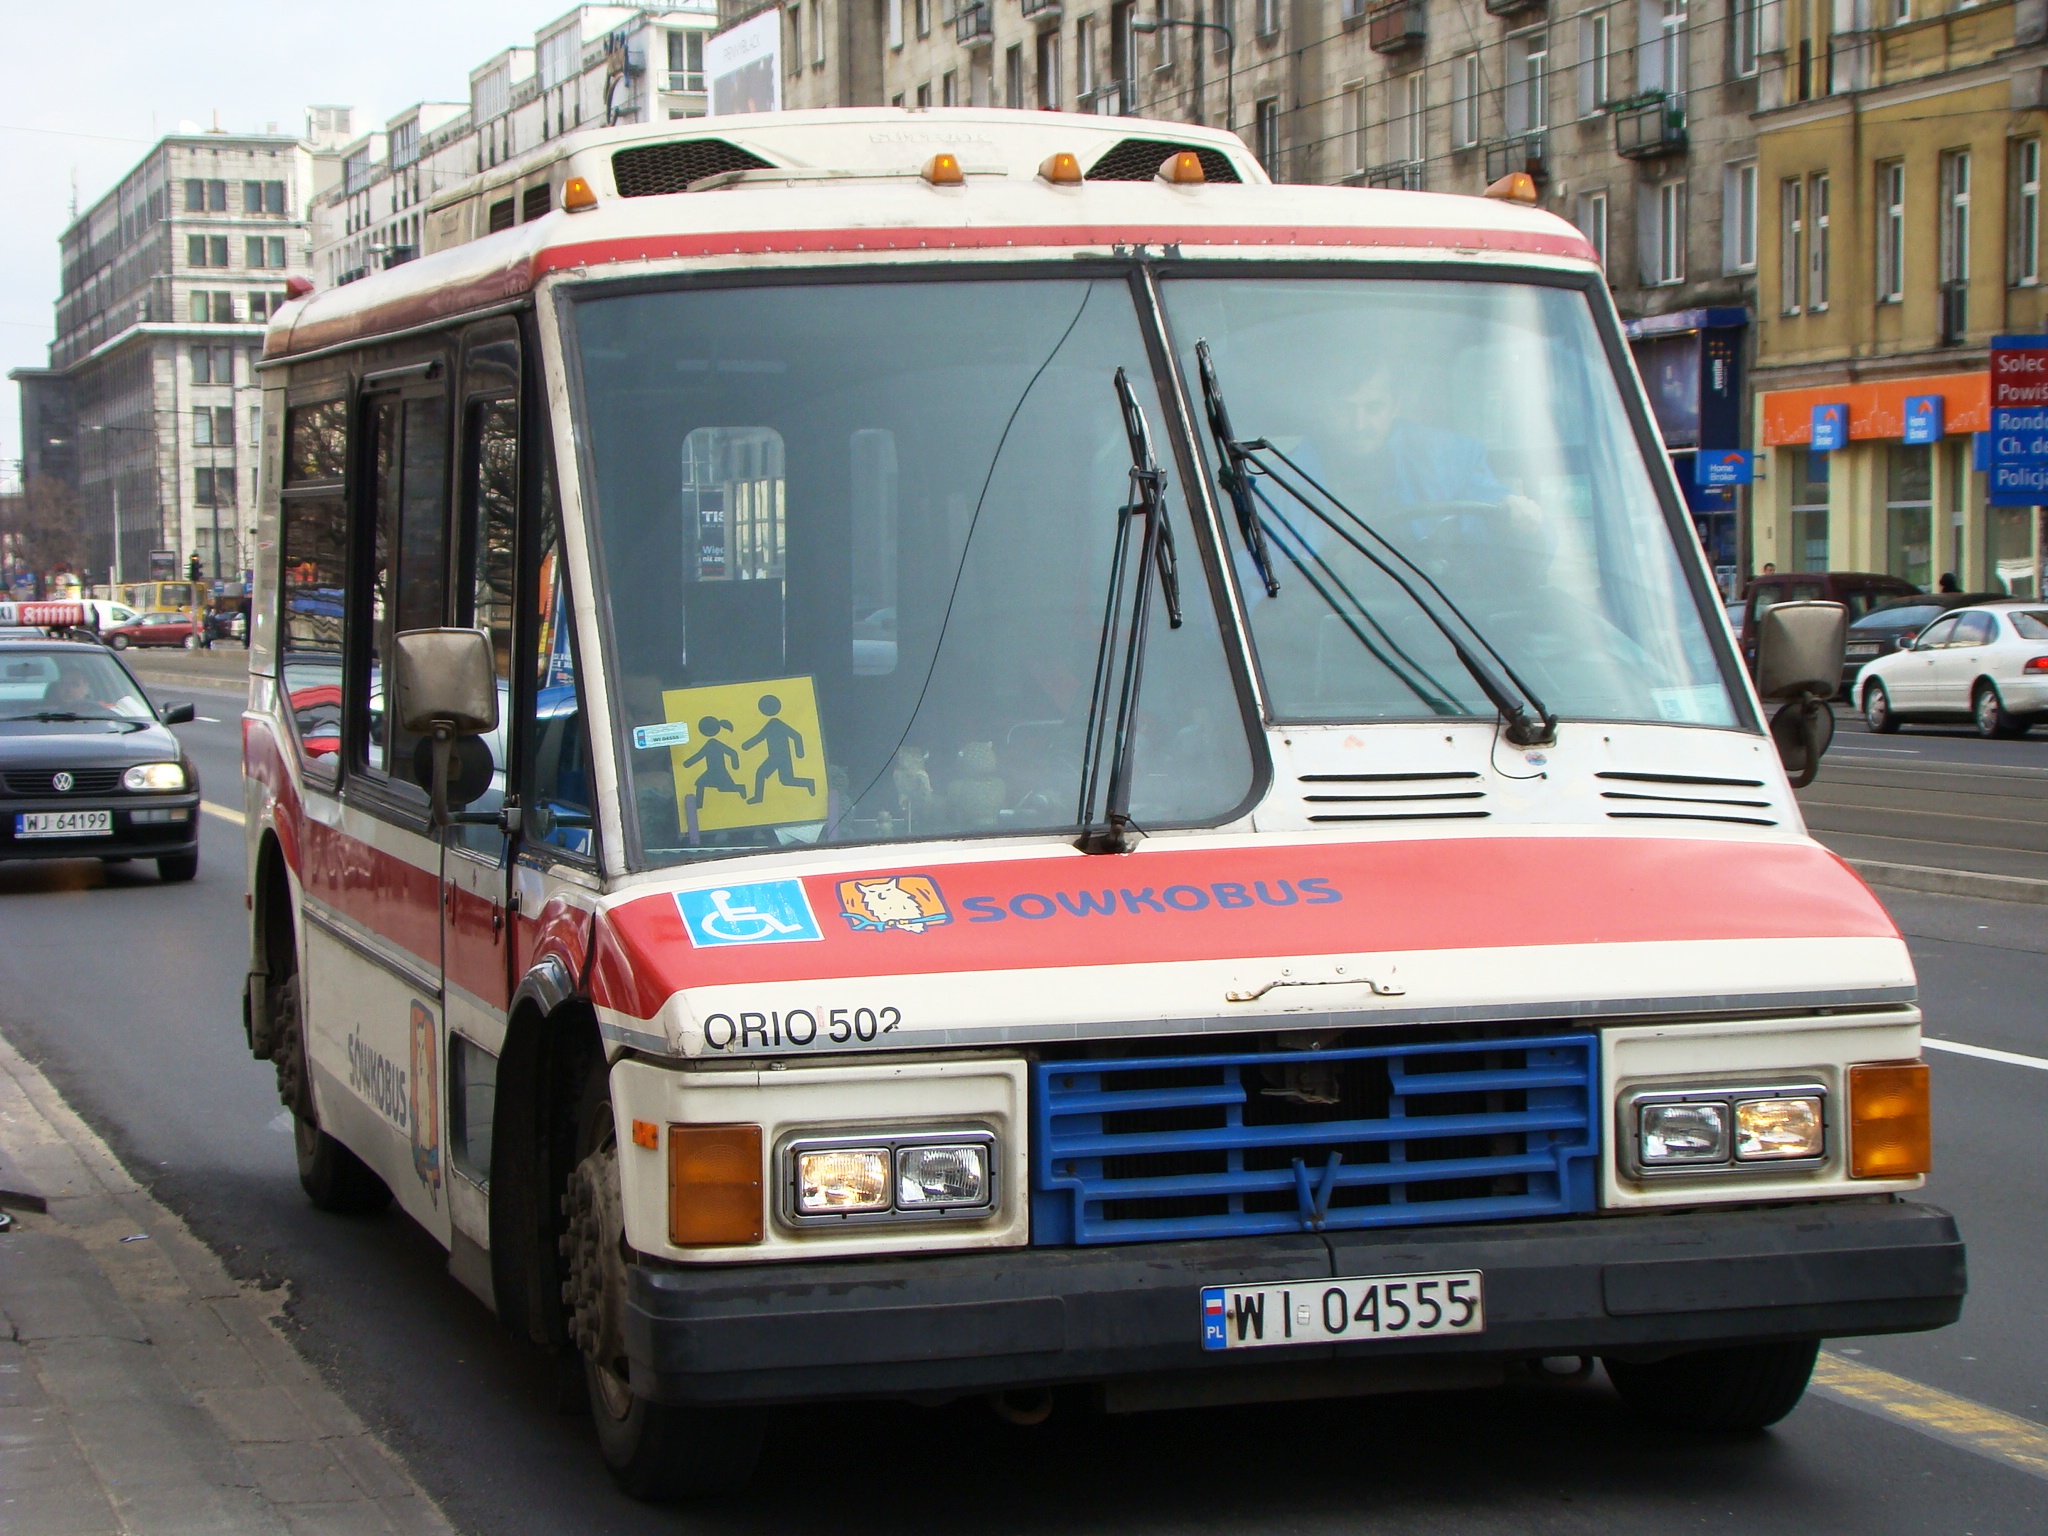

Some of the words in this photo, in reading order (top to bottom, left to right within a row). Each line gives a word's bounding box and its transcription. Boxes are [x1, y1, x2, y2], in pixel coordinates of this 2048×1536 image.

[1998, 354, 2046, 373] Solec
[1816, 424, 1832, 434] Home
[1909, 415, 1926, 427] Home
[1998, 437, 2027, 455] Ch.
[1710, 463, 1734, 472] Home
[1710, 472, 1737, 481] Broker
[23, 606, 78, 625] 8111111
[26, 815, 48, 831] WJ
[56, 813, 107, 830] 64199
[961, 877, 1343, 923] SOWKOBUS
[703, 1009, 817, 1050] ORIO
[829, 1006, 902, 1044] 502
[1233, 1290, 1292, 1341] WI
[1322, 1279, 1475, 1335] 04555
[1206, 1325, 1224, 1340] PL
